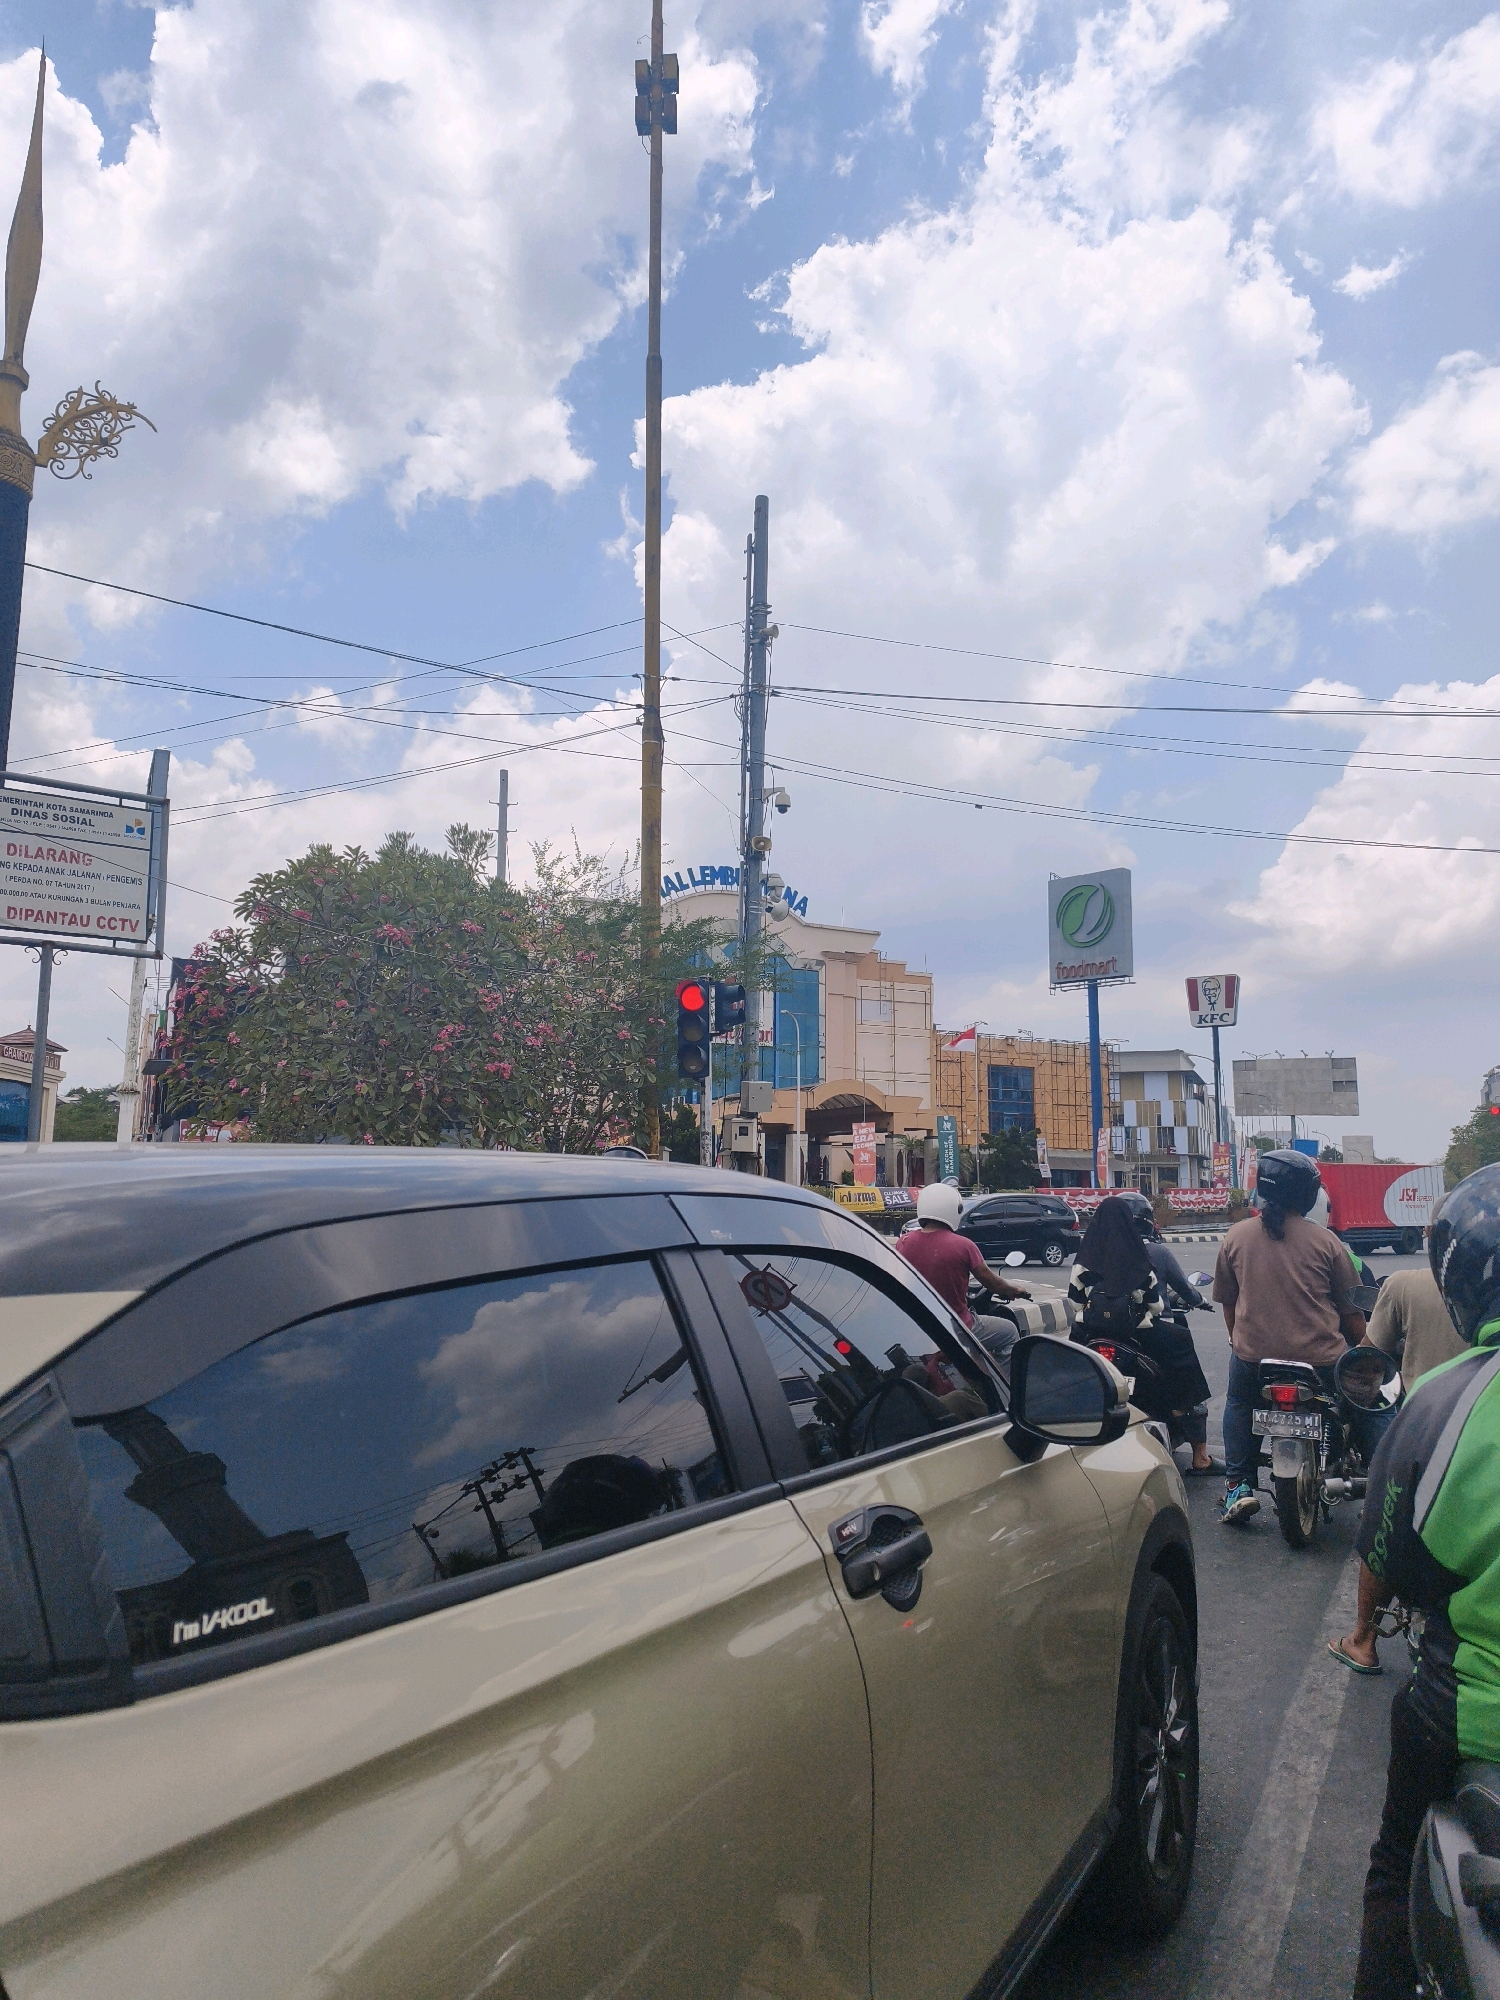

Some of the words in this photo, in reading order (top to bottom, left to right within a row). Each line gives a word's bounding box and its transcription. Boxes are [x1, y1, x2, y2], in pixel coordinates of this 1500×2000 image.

[11, 808, 48, 820] DINAS
[52, 813, 95, 827] SOSIAL
[46, 803, 67, 812] KOTA
[69, 806, 114, 818] SAMARINDA
[13, 862, 43, 874] KEPADA
[45, 866, 66, 876] ANAK
[66, 868, 102, 880] JALANAN
[106, 874, 142, 886] PENGEMIS
[9, 876, 31, 884] PERDA
[55, 880, 76, 890] TAHUN
[48, 894, 84, 904] KURUNGAN
[90, 898, 111, 906] BULAN
[112, 901, 140, 910] PENJARA
[6, 906, 90, 928] DIPANTAU
[96, 916, 140, 932] CCTV
[1055, 956, 1118, 980] foodmart
[1196, 1012, 1230, 1024] KFC
[854, 1134, 874, 1143] ERA
[1214, 1157, 1230, 1166] EAT
[840, 1191, 876, 1202] informa
[884, 1194, 911, 1204] SALE
[1398, 1188, 1418, 1202] J&T
[1255, 1412, 1268, 1422] KT
[173, 1622, 200, 1644] I'm
[202, 1597, 276, 1636] V-KOOL
